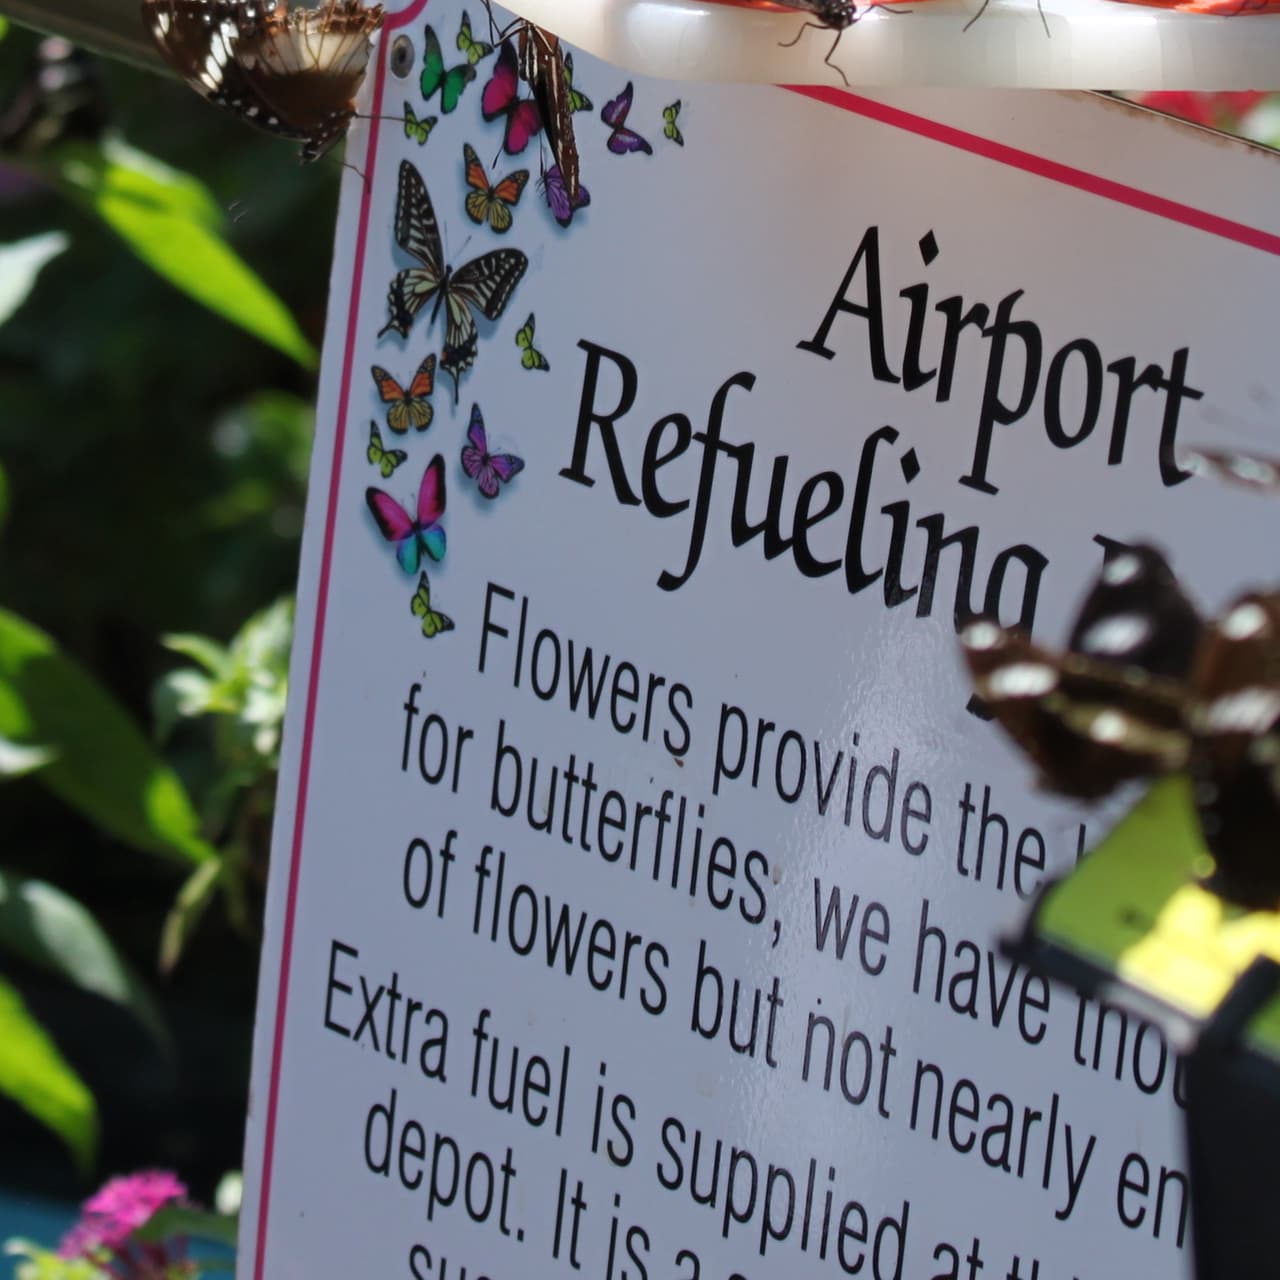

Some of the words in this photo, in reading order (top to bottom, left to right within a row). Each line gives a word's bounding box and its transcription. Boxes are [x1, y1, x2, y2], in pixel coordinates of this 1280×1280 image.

[795, 225, 1205, 496] Airport
[401, 682, 475, 794] for
[490, 718, 782, 950] butterflies,
[813, 877, 891, 978] we
[912, 898, 1052, 1046] have
[478, 581, 693, 758] Flowers
[711, 702, 932, 856] provide
[956, 782, 1046, 900] the
[323, 939, 449, 1084] Extra
[470, 1008, 571, 1137] fuel
[591, 1061, 636, 1168] is
[656, 1116, 910, 1280] supplied
[364, 1087, 525, 1243] depot.
[552, 1167, 588, 1271] It
[605, 1193, 651, 1280] is
[403, 829, 459, 920] of
[472, 844, 670, 1016] flowers
[690, 938, 784, 1069] but
[801, 1011, 897, 1119] not
[909, 1059, 1097, 1222] nearly
